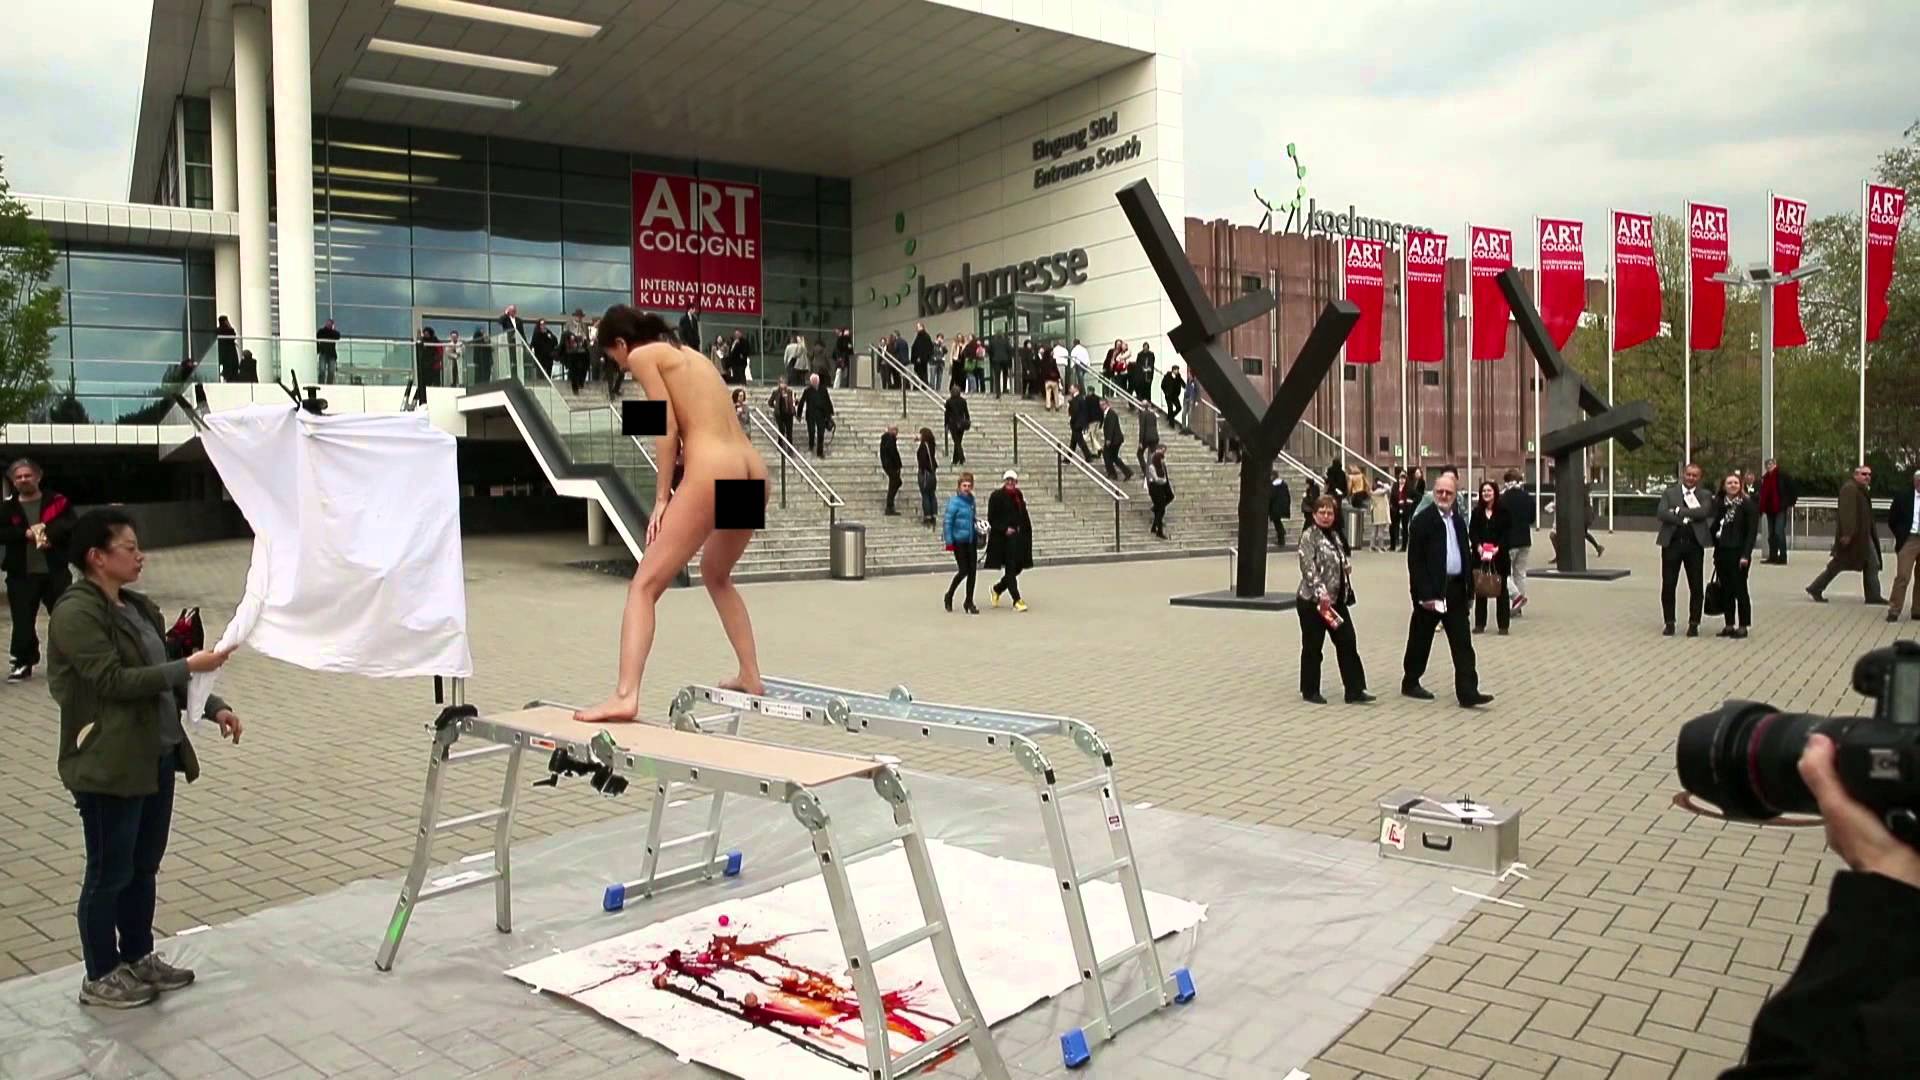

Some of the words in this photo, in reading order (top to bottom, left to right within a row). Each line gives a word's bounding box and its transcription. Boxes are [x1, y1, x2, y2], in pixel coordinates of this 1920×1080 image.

[1032, 128, 1087, 161] Eingang
[1033, 157, 1096, 189] Entrance
[1096, 135, 1142, 167] South
[640, 177, 754, 235] ART
[1776, 201, 1805, 226] ART
[1870, 191, 1904, 215] ART
[1617, 216, 1651, 239] ART
[1692, 209, 1726, 232] ART
[639, 230, 756, 259] COLOGNE
[1473, 231, 1510, 253] ART
[1542, 223, 1581, 245] ART
[1347, 241, 1382, 262] ART
[1408, 236, 1446, 257] ART
[640, 278, 756, 297] INTERNATIONALER
[917, 247, 1089, 317] koelnmesse
[640, 292, 756, 311] KUNSTMARKT
